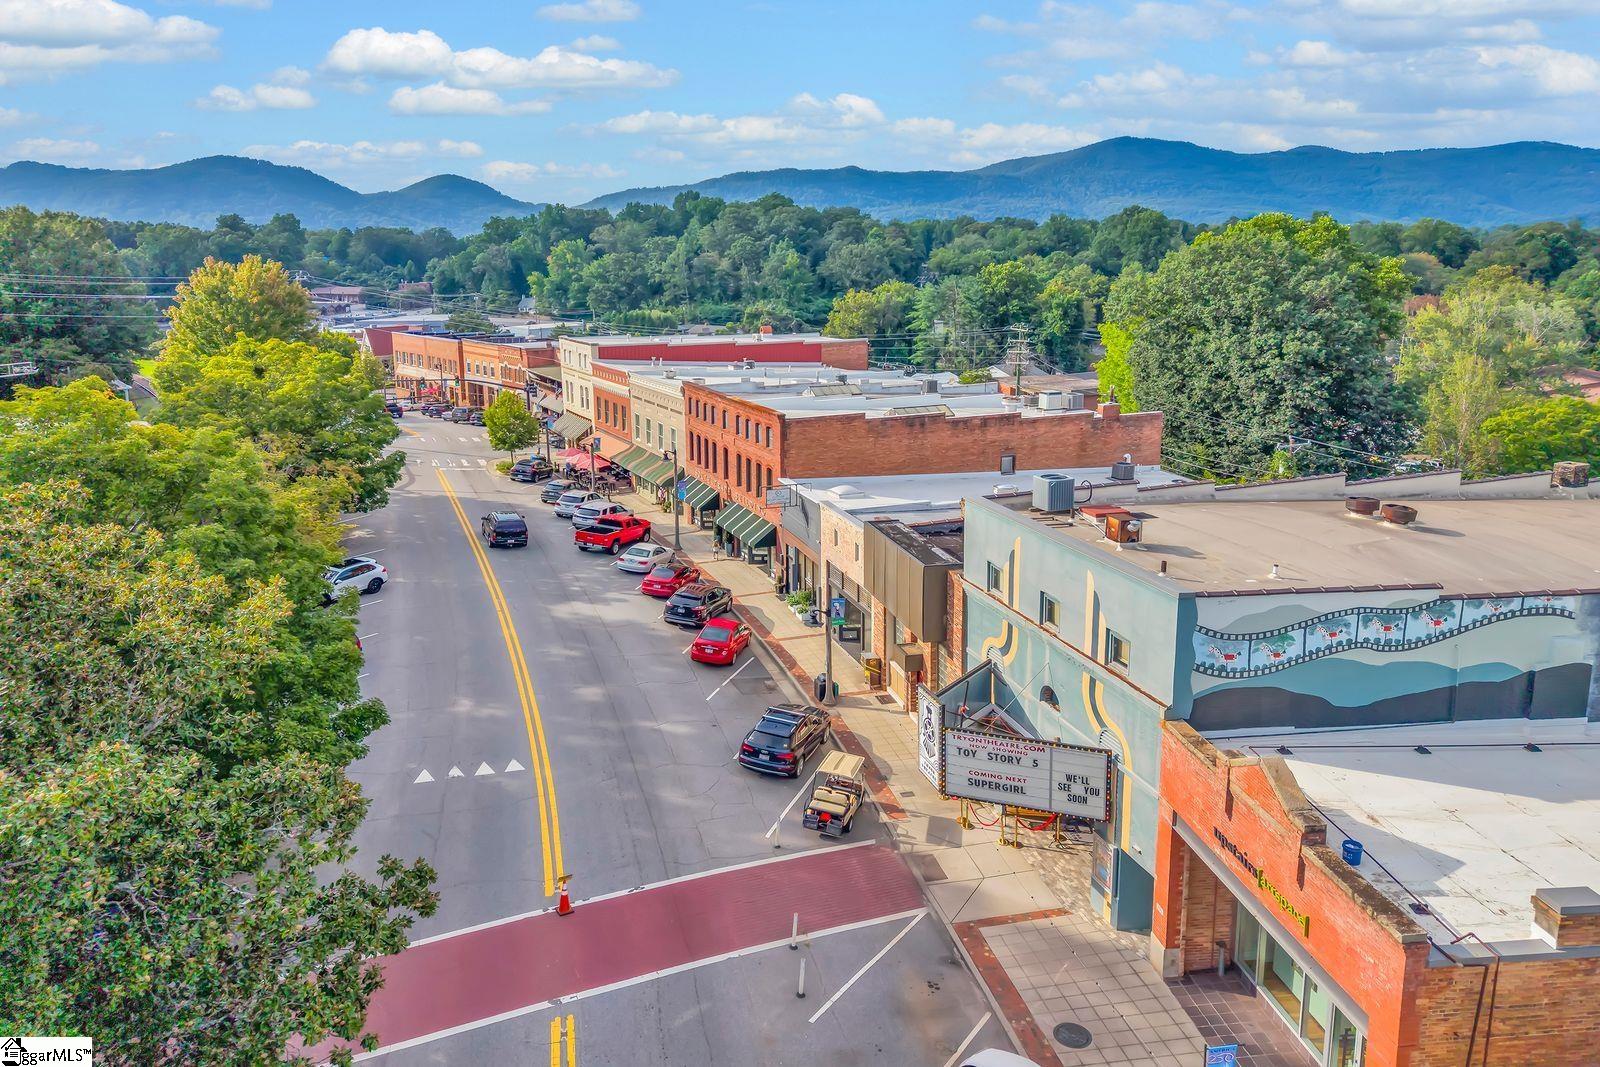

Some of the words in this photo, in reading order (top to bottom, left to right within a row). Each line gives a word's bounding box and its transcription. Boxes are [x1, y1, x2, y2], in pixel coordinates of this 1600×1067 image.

[952, 734, 1046, 753] TRYONTHEATRE.COM
[956, 747, 977, 758] TOY
[987, 752, 1022, 765] STORY
[1032, 759, 1039, 768] 5
[992, 746, 1028, 756] SHOWING
[968, 770, 1003, 780] COMING
[1005, 776, 1027, 784] NEXT
[1065, 773, 1090, 786] WE'LL
[967, 777, 1027, 795] SUPERGIRL
[1057, 782, 1072, 792] SEE
[1083, 786, 1100, 797] YOU
[1067, 793, 1088, 804] SOON
